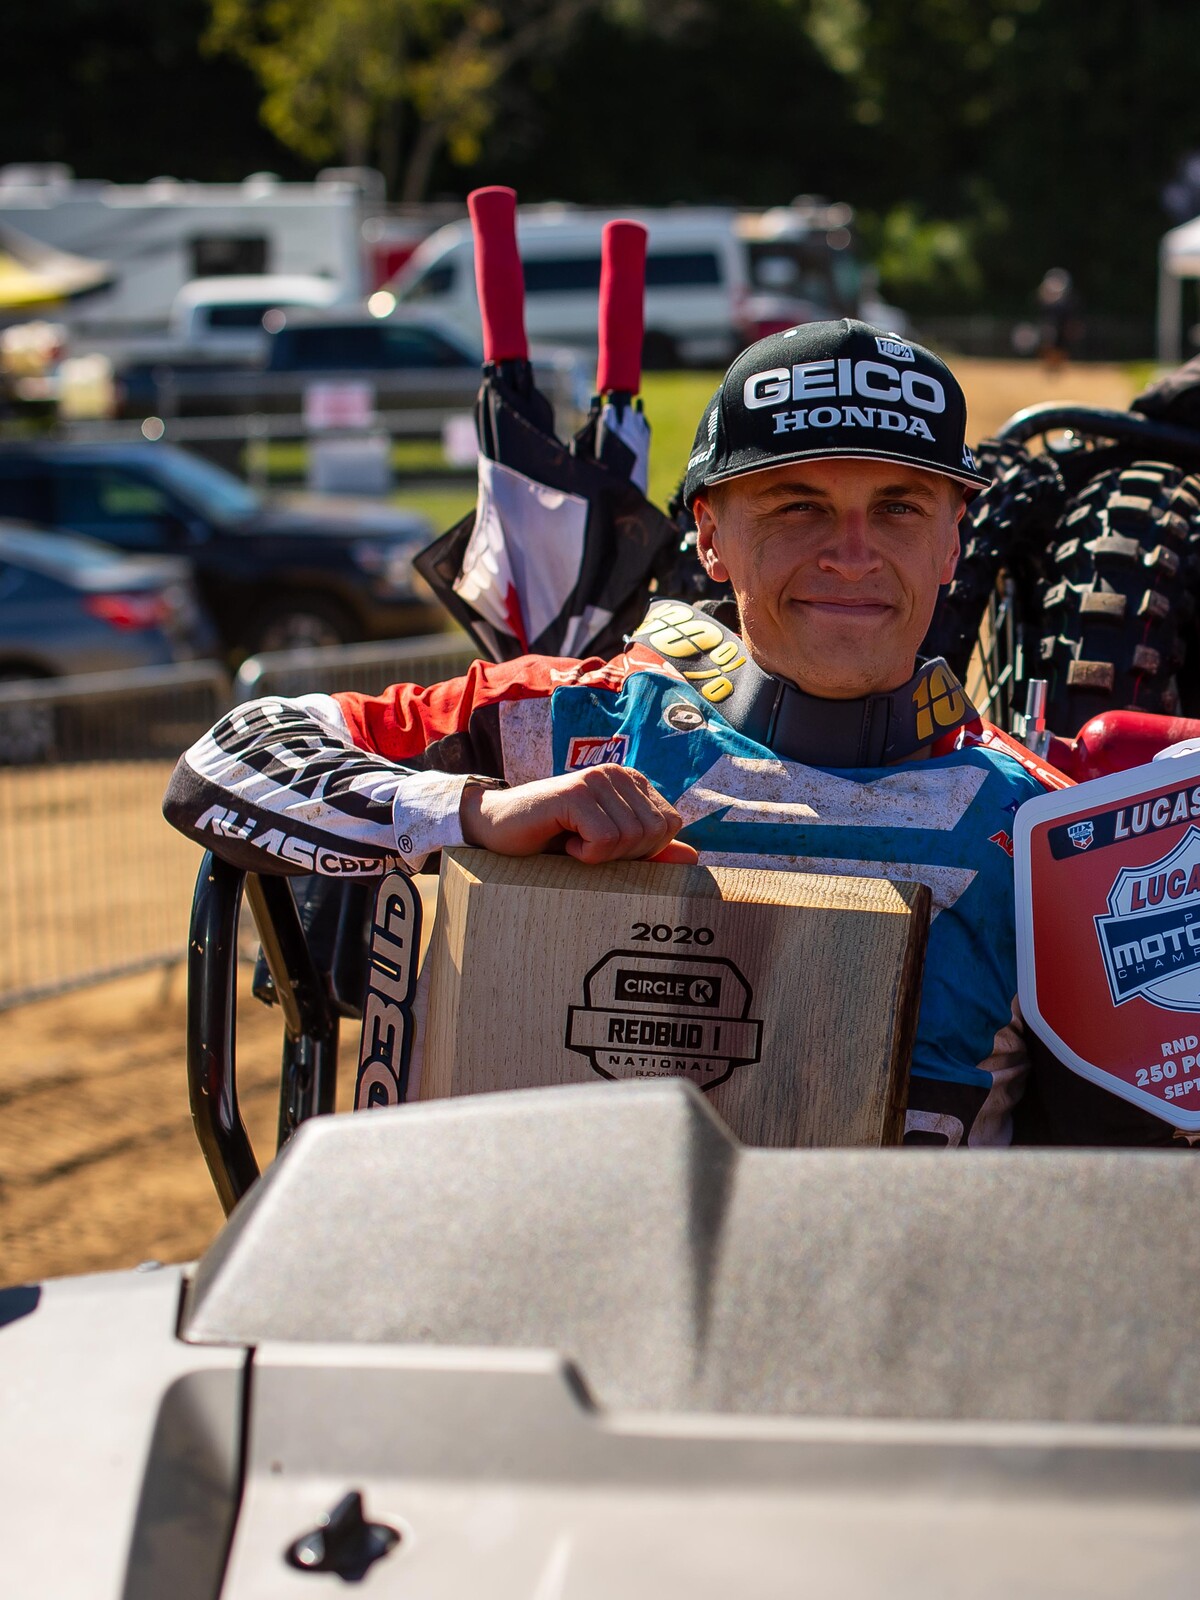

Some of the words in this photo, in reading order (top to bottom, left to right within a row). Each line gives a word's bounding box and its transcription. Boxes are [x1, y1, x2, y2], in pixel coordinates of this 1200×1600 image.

[881, 340, 911, 358] 100%
[744, 358, 945, 413] GEICO
[773, 406, 936, 442] HONDA
[320, 852, 382, 873] CBD
[631, 922, 715, 946] 2020
[624, 979, 685, 997] CIRCLE
[608, 1018, 703, 1049] REDBUD
[1161, 1036, 1198, 1057] RND
[609, 1055, 714, 1072] NATIONAL
[1135, 1061, 1178, 1087] 250
